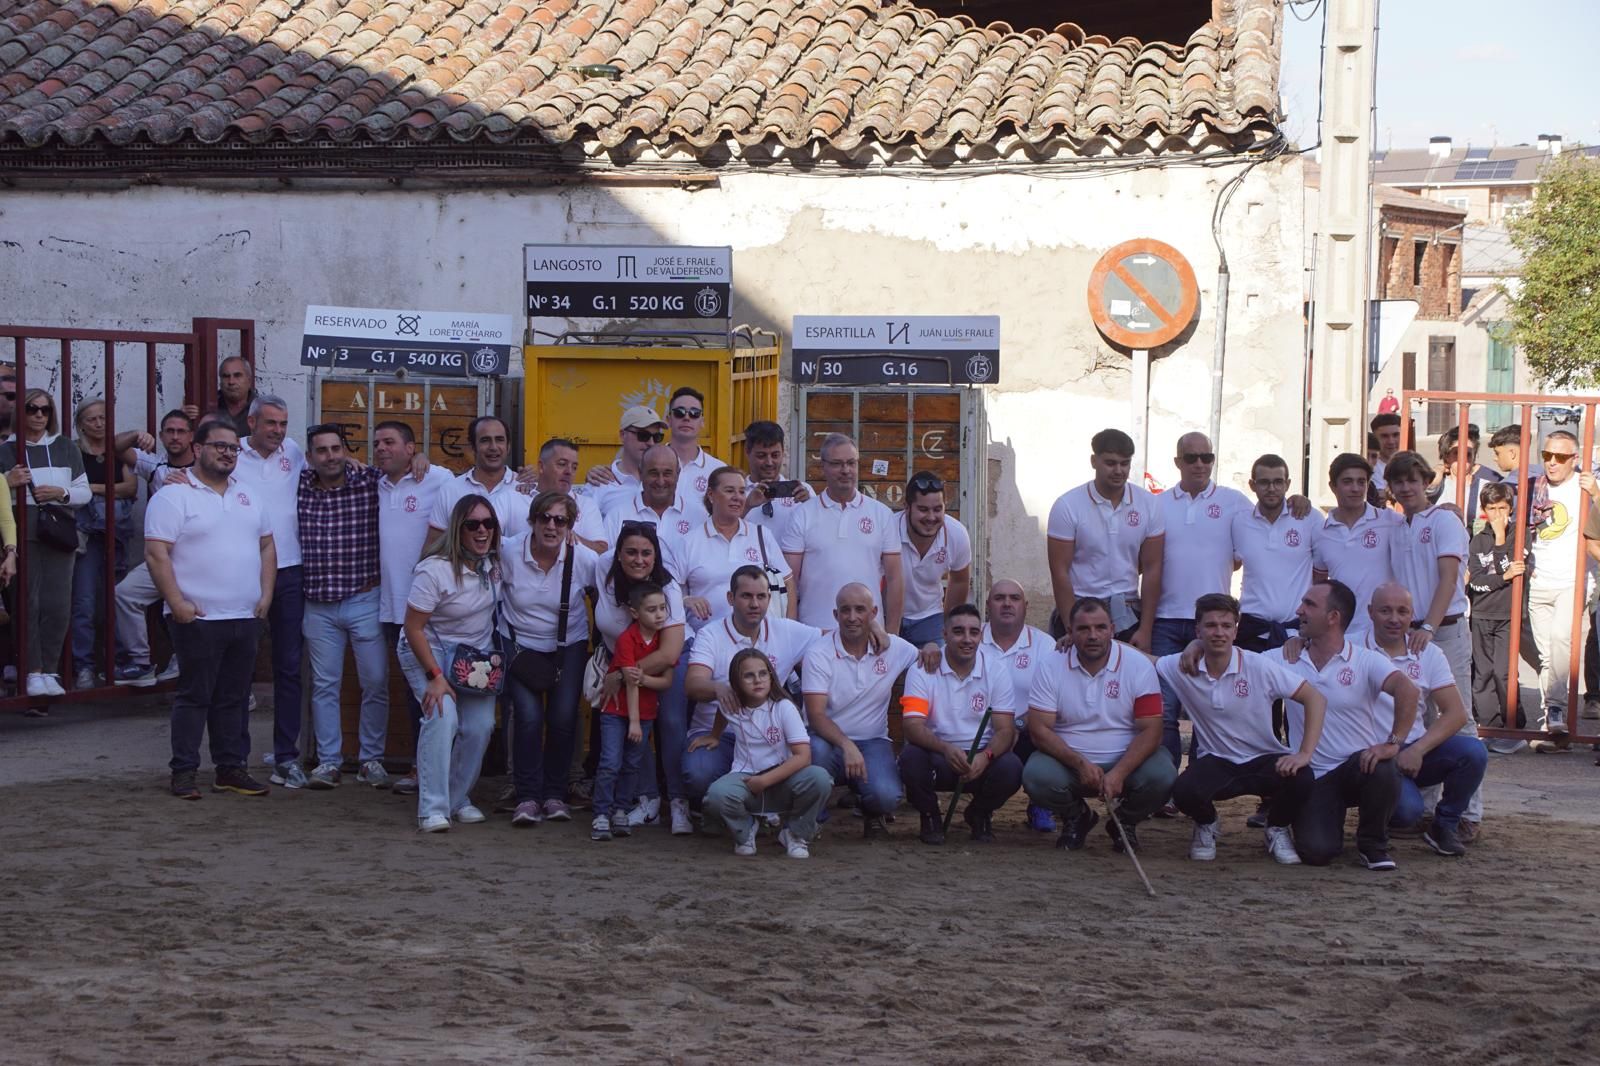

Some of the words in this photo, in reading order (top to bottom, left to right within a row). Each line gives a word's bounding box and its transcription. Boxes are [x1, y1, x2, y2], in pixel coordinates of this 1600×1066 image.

[533, 259, 602, 271] LANGOSTO
[653, 256, 675, 266] JOSÉ
[677, 257, 684, 266] E.
[686, 257, 716, 266] FRAILE
[646, 267, 659, 276] DE
[660, 267, 724, 276] VALDEFRESNO
[552, 295, 571, 310] 34
[593, 295, 616, 310] G.1
[629, 296, 658, 310] 520
[663, 296, 684, 310] KG
[314, 315, 387, 329] RESERVADO
[451, 320, 480, 329] MARÍA
[429, 328, 464, 337] LORETO
[465, 329, 502, 339] CHARRO
[805, 327, 876, 338] ESPARTILLA
[918, 327, 942, 337] JUÁN
[944, 327, 963, 337] LUÍS
[965, 328, 994, 337] FRAILE
[371, 350, 395, 363] G.1
[408, 352, 436, 366] 540
[440, 353, 462, 367] KG
[823, 362, 843, 376] 30
[882, 362, 918, 376] G.16
[350, 390, 448, 411] ALBA
